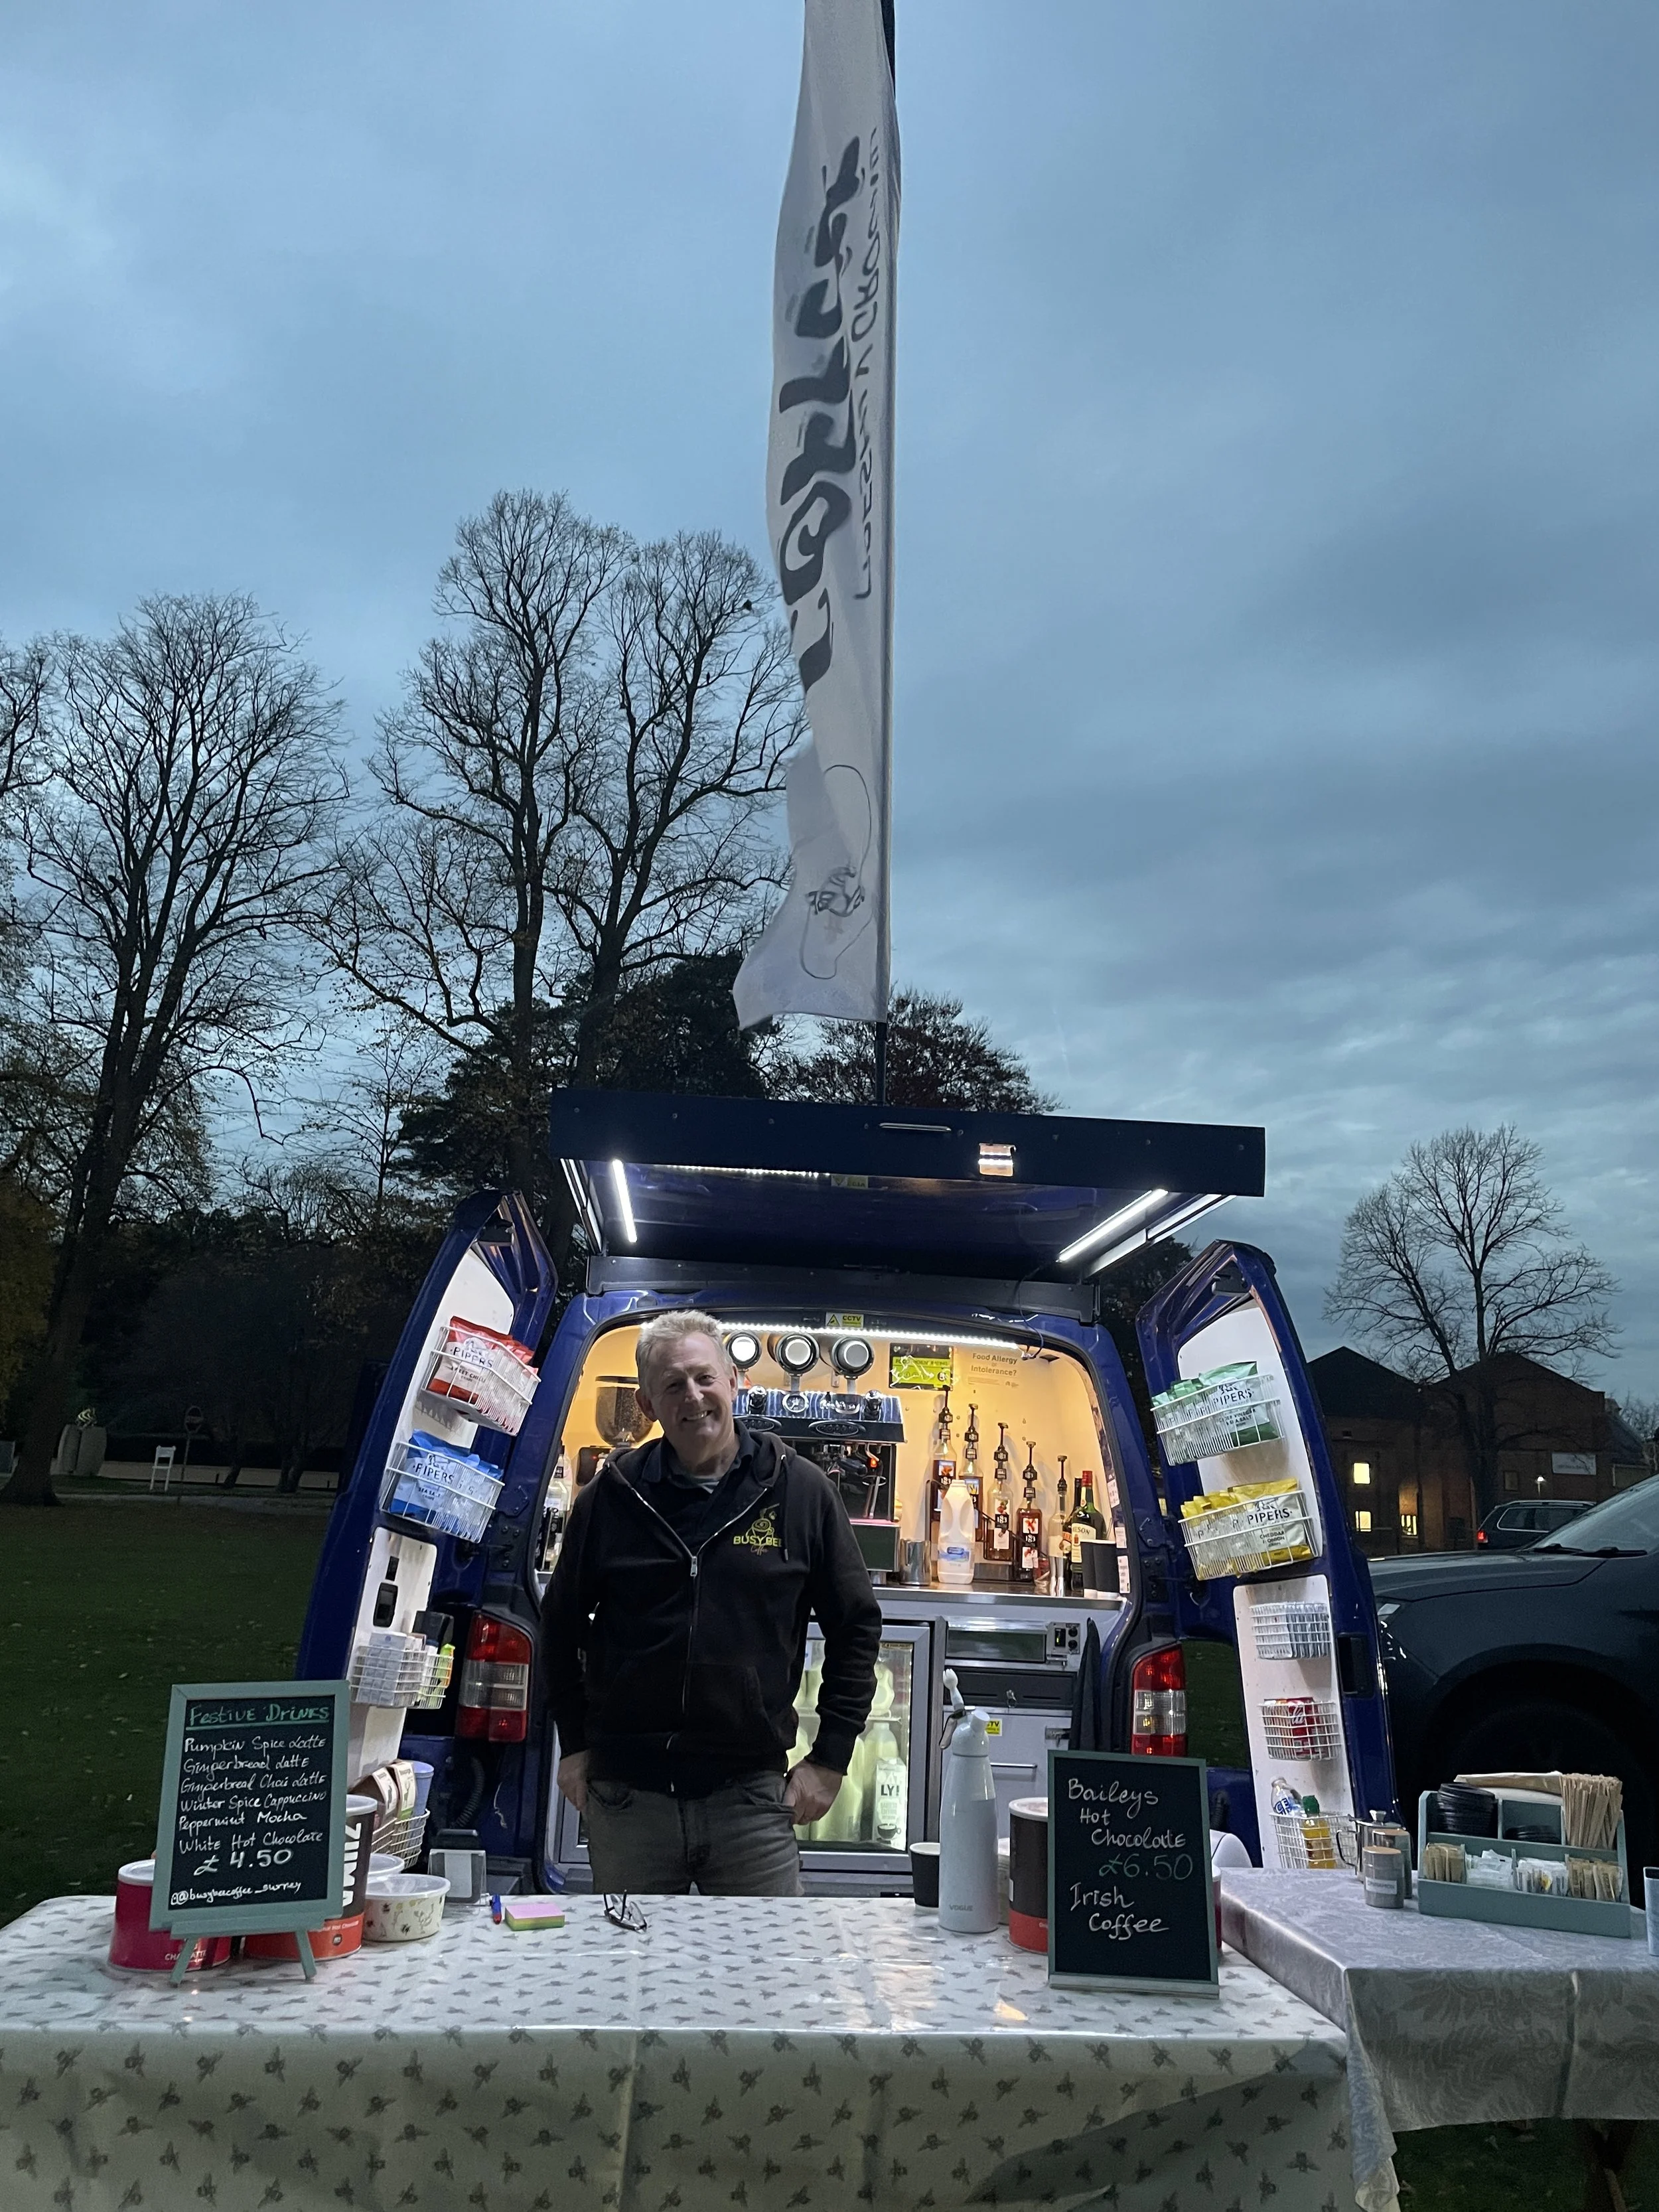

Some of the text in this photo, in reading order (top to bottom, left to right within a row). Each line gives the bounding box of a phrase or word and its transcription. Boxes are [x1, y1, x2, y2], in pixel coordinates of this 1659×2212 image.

[453, 1347, 494, 1368] PIPERS
[991, 1354, 1018, 1364] Allergy
[971, 1365, 1017, 1376] Intolerance?
[1213, 1388, 1252, 1406] PIPERS
[415, 1463, 455, 1485] PIPERS
[1247, 1508, 1290, 1525] PIPERS
[252, 1736, 285, 1757] Spice
[259, 1774, 289, 1789] Chai
[881, 1784, 899, 1797] LY!
[228, 1795, 262, 1815] Spice
[1068, 1777, 1159, 1819] Baileys
[257, 1810, 308, 1824] Mocha
[1080, 1807, 1111, 1826] Hot
[232, 1832, 256, 1851] Hot
[263, 1828, 323, 1846] Chocolate
[1091, 1826, 1187, 1850] Chocolate
[230, 1848, 293, 1869] 4.50
[1098, 1853, 1193, 1880] £6.50
[1070, 1881, 1135, 1911] Irish
[1089, 1913, 1170, 1941] Coffee
